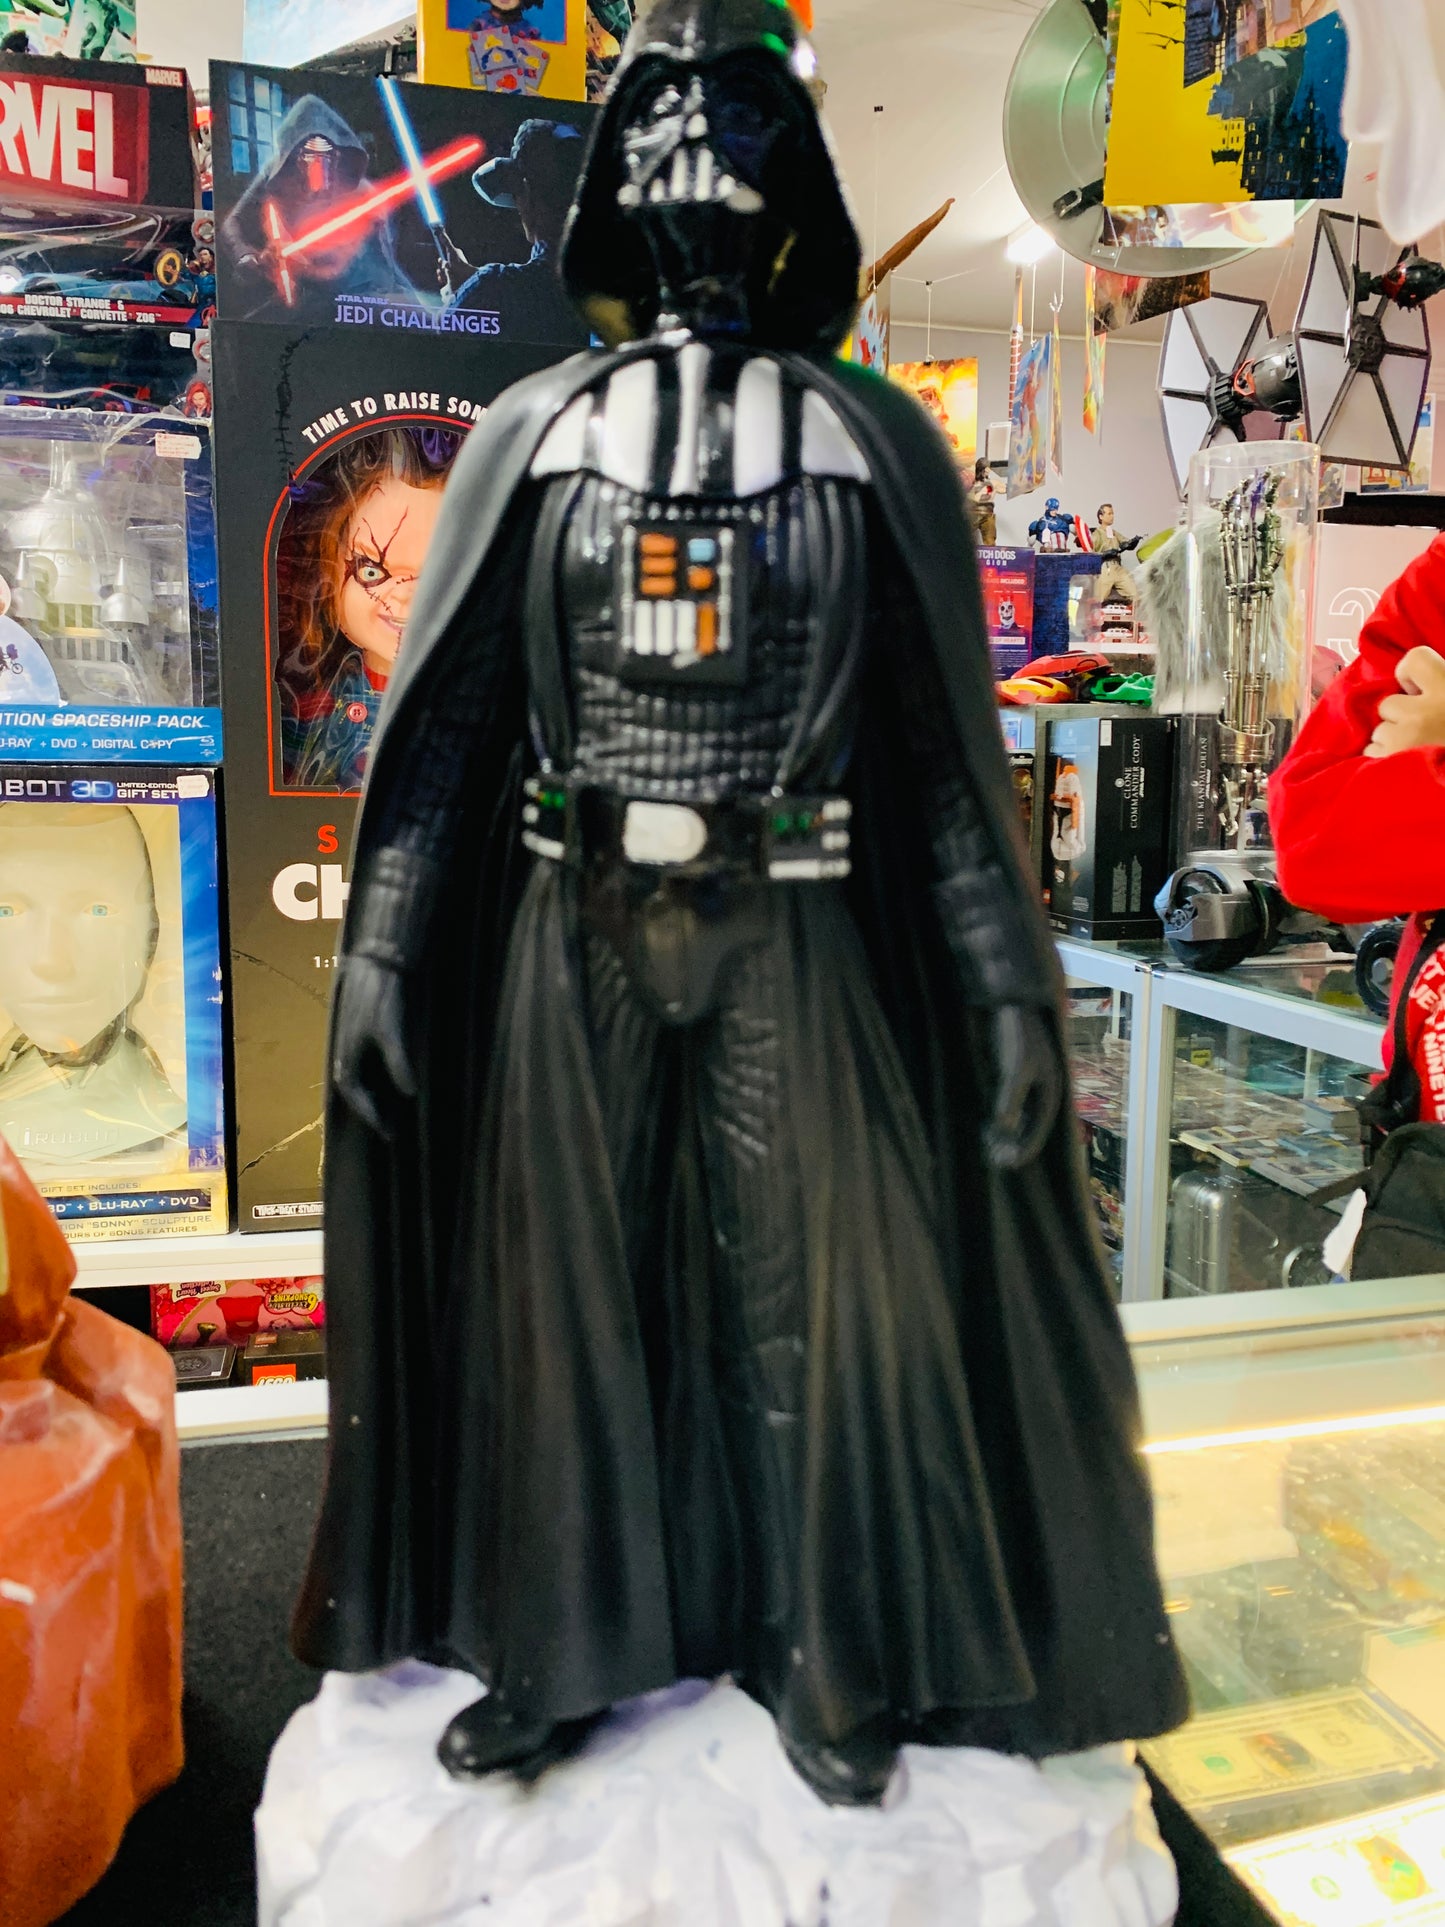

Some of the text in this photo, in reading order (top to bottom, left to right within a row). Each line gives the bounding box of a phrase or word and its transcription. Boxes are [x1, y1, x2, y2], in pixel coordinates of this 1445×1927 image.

[146, 68, 183, 86] MARVEL
[24, 294, 63, 306] DOCTOR
[66, 297, 111, 309] STRANGE
[335, 305, 500, 334] JEDI CHALLENGES
[302, 407, 349, 444] TIME
[351, 397, 377, 418] TO
[384, 392, 440, 411] RAISE
[995, 550, 1016, 560] DOGS
[52, 713, 151, 728] SPACESHIP
[157, 715, 205, 728] PACK
[51, 738, 77, 748] DVD
[92, 739, 137, 749] DIGITAL
[1198, 737, 1207, 809] MANDALORIAN
[1124, 767, 1133, 799] CLONE
[1130, 734, 1141, 828] COMMANDER CODY
[0, 780, 114, 798] BOT 3D
[117, 789, 179, 798] GIFT SET
[170, 1196, 199, 1206] DVD
[142, 1215, 212, 1226] SCULPTURE
[147, 1226, 197, 1235] FEATURES
